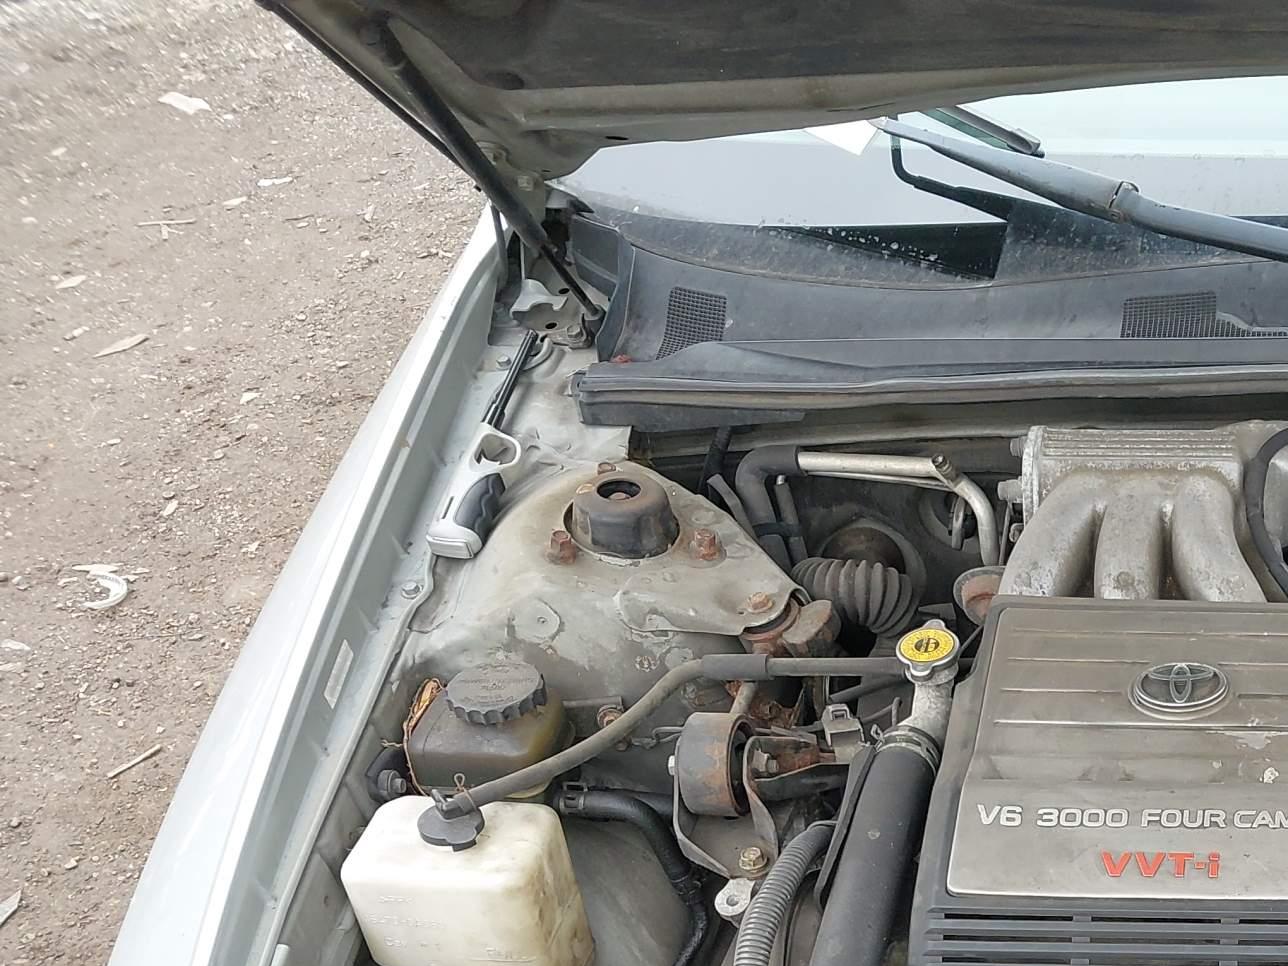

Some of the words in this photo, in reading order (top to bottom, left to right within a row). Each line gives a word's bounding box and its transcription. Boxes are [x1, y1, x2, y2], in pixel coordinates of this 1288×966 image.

[977, 804, 1023, 827] V6
[1036, 807, 1129, 829] 3000
[1140, 808, 1227, 829] FOUR
[1101, 851, 1221, 879] VVT-i
